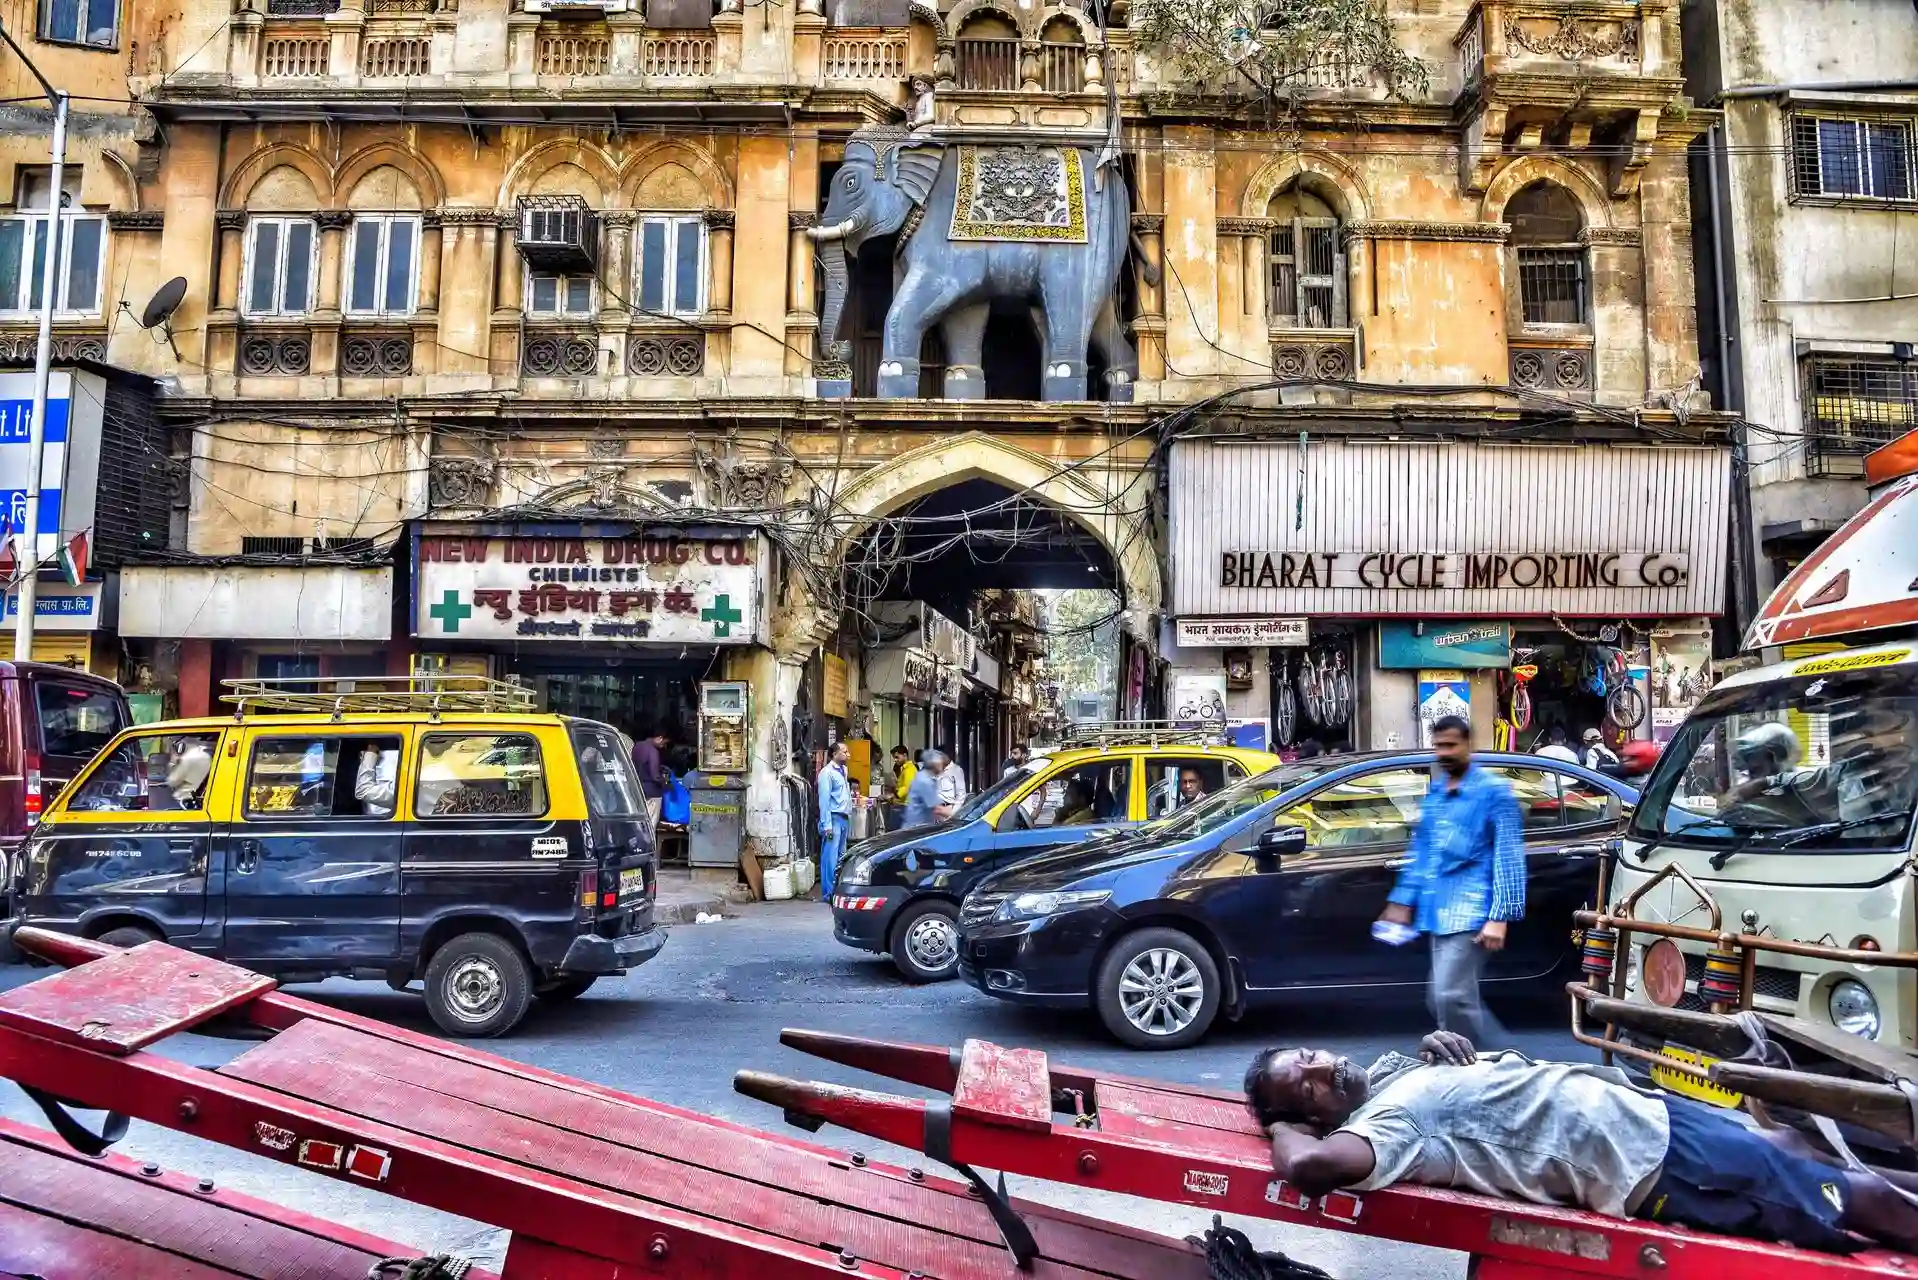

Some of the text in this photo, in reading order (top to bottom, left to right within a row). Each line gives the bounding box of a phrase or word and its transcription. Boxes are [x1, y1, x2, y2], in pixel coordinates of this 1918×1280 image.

[15, 404, 32, 436] Lt
[421, 540, 751, 565] NEW INDIA DRUG CO.
[528, 567, 639, 582] CHEMISTS
[1222, 552, 1687, 588] BHARAT CYCLE IMPORTING Co.
[517, 584, 602, 616] इंडिया
[1185, 625, 1209, 635] भारत
[1433, 624, 1501, 646] urban trail
